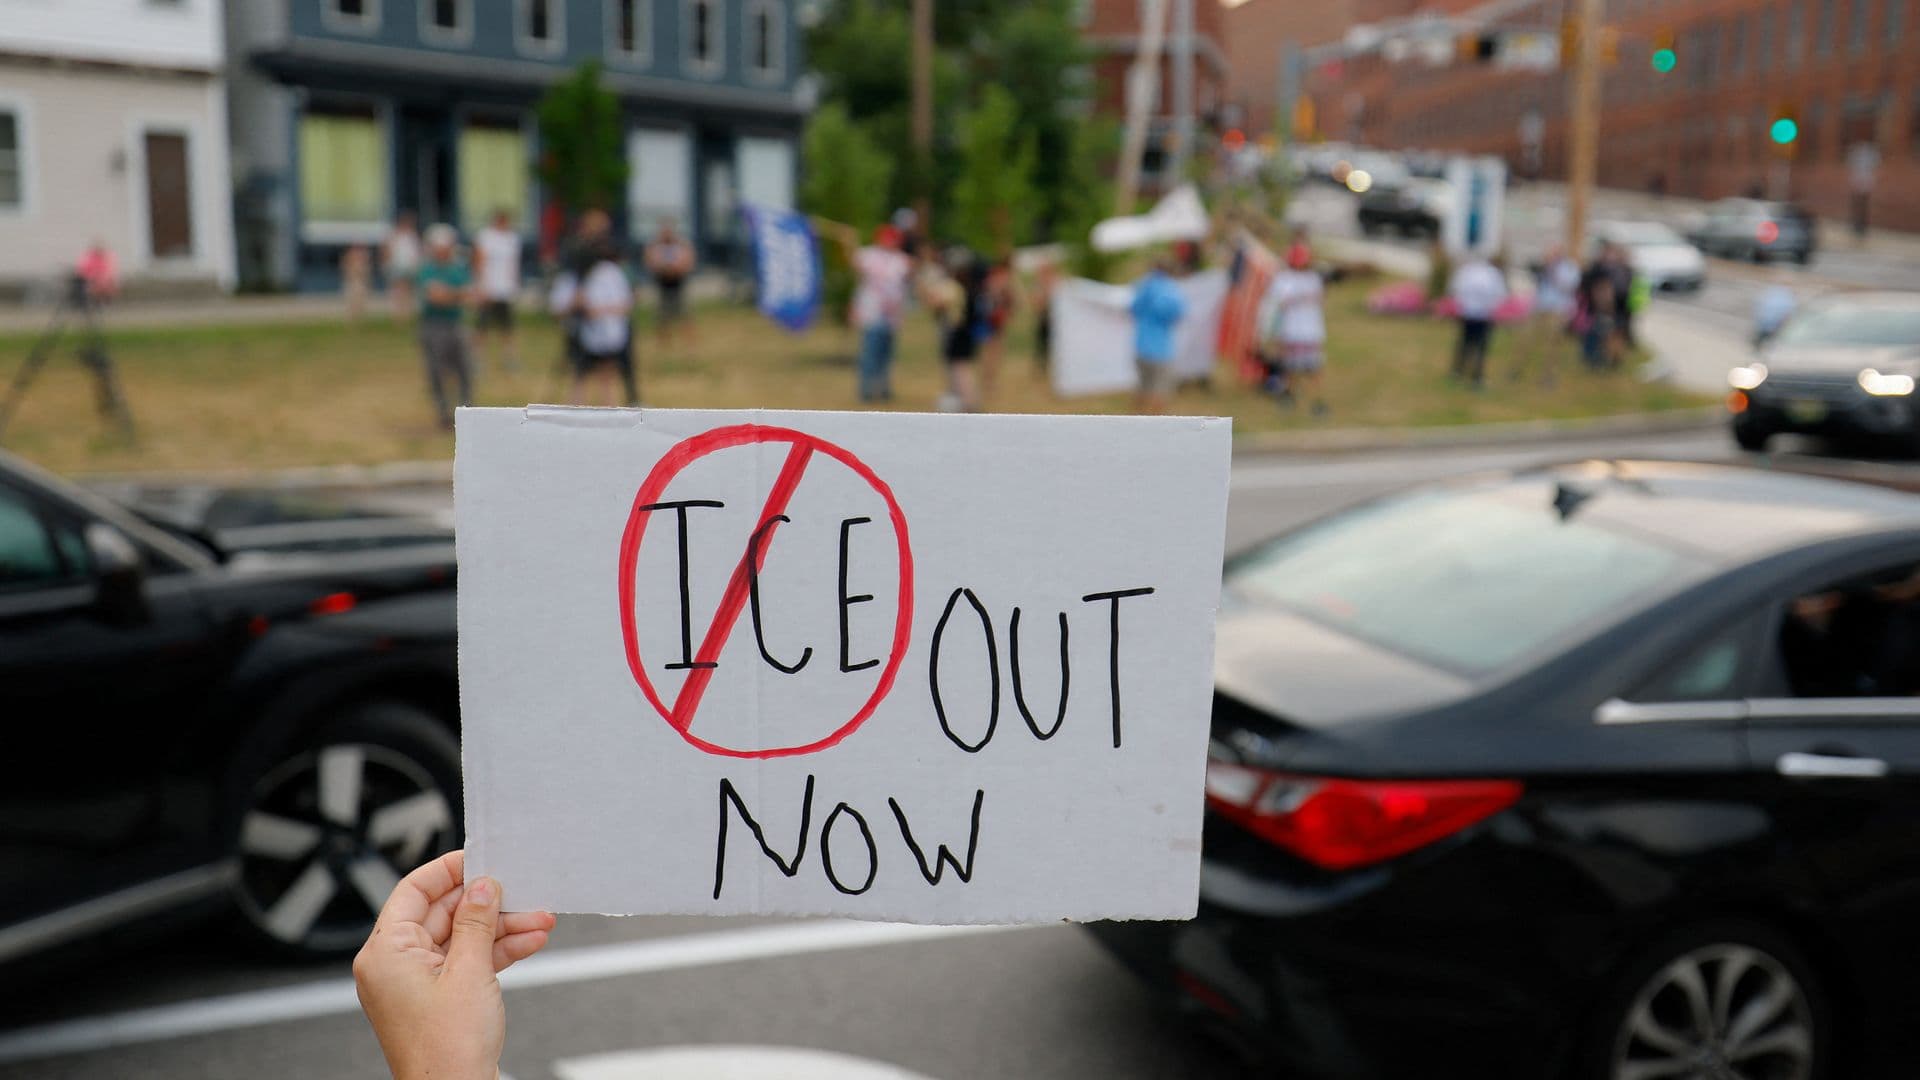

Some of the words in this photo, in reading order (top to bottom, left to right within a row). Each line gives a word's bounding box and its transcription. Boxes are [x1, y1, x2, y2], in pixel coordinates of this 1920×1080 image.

[638, 498, 882, 676] ICE
[929, 585, 1156, 755] OUT
[712, 773, 985, 902] NOW
